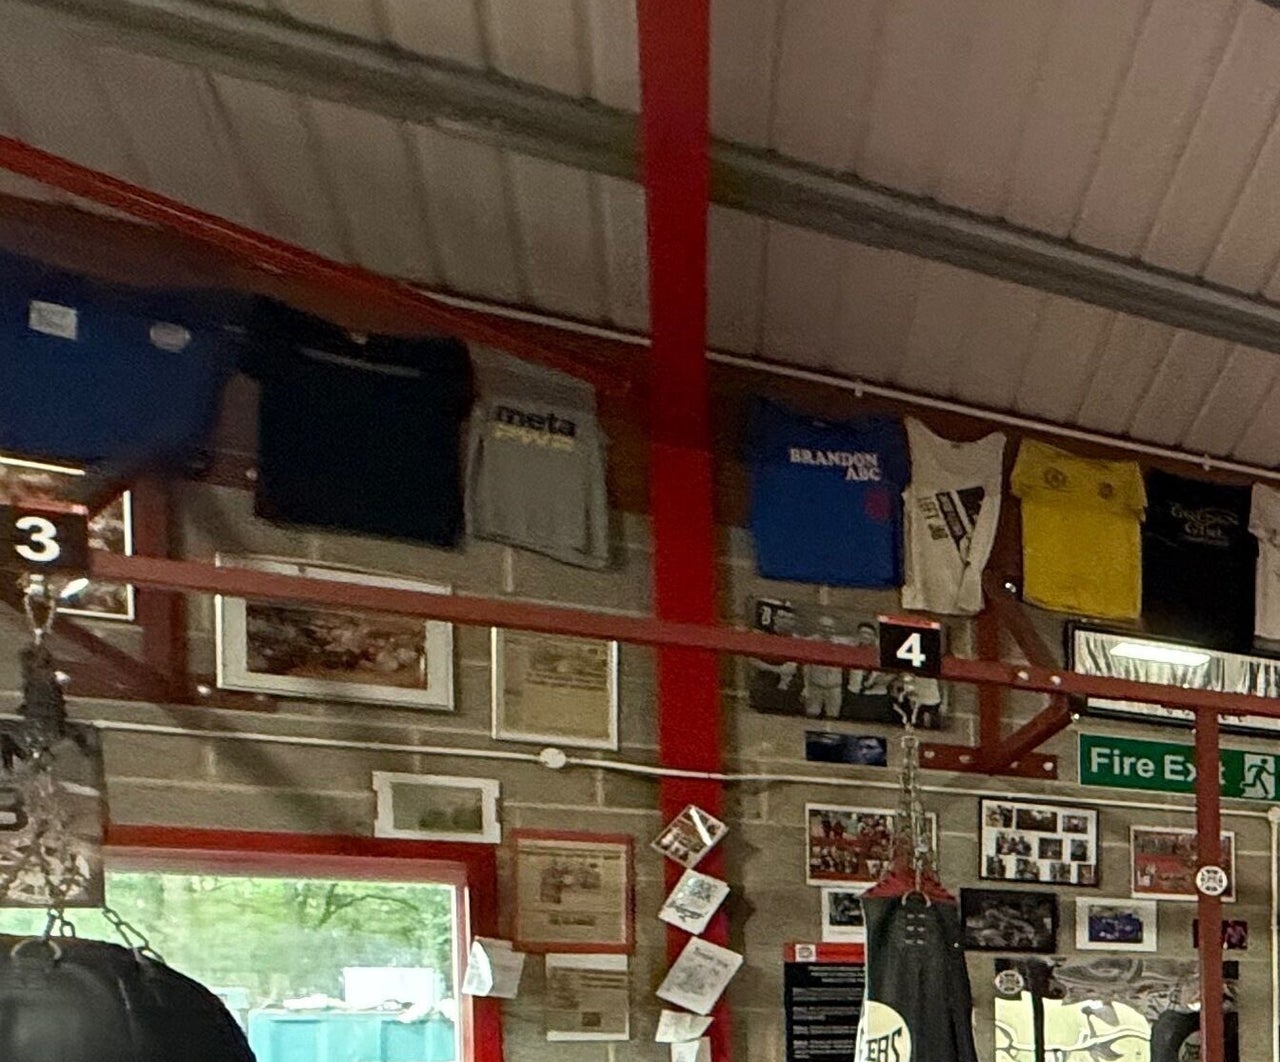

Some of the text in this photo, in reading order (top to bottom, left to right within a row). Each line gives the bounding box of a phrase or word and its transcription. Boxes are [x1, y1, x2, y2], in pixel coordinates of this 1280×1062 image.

[497, 406, 577, 437] meta
[790, 448, 878, 468] BRANDON
[845, 467, 881, 481] ABC
[15, 516, 61, 562] 3
[896, 632, 926, 668] 4
[1090, 746, 1226, 785] Fire Ex
